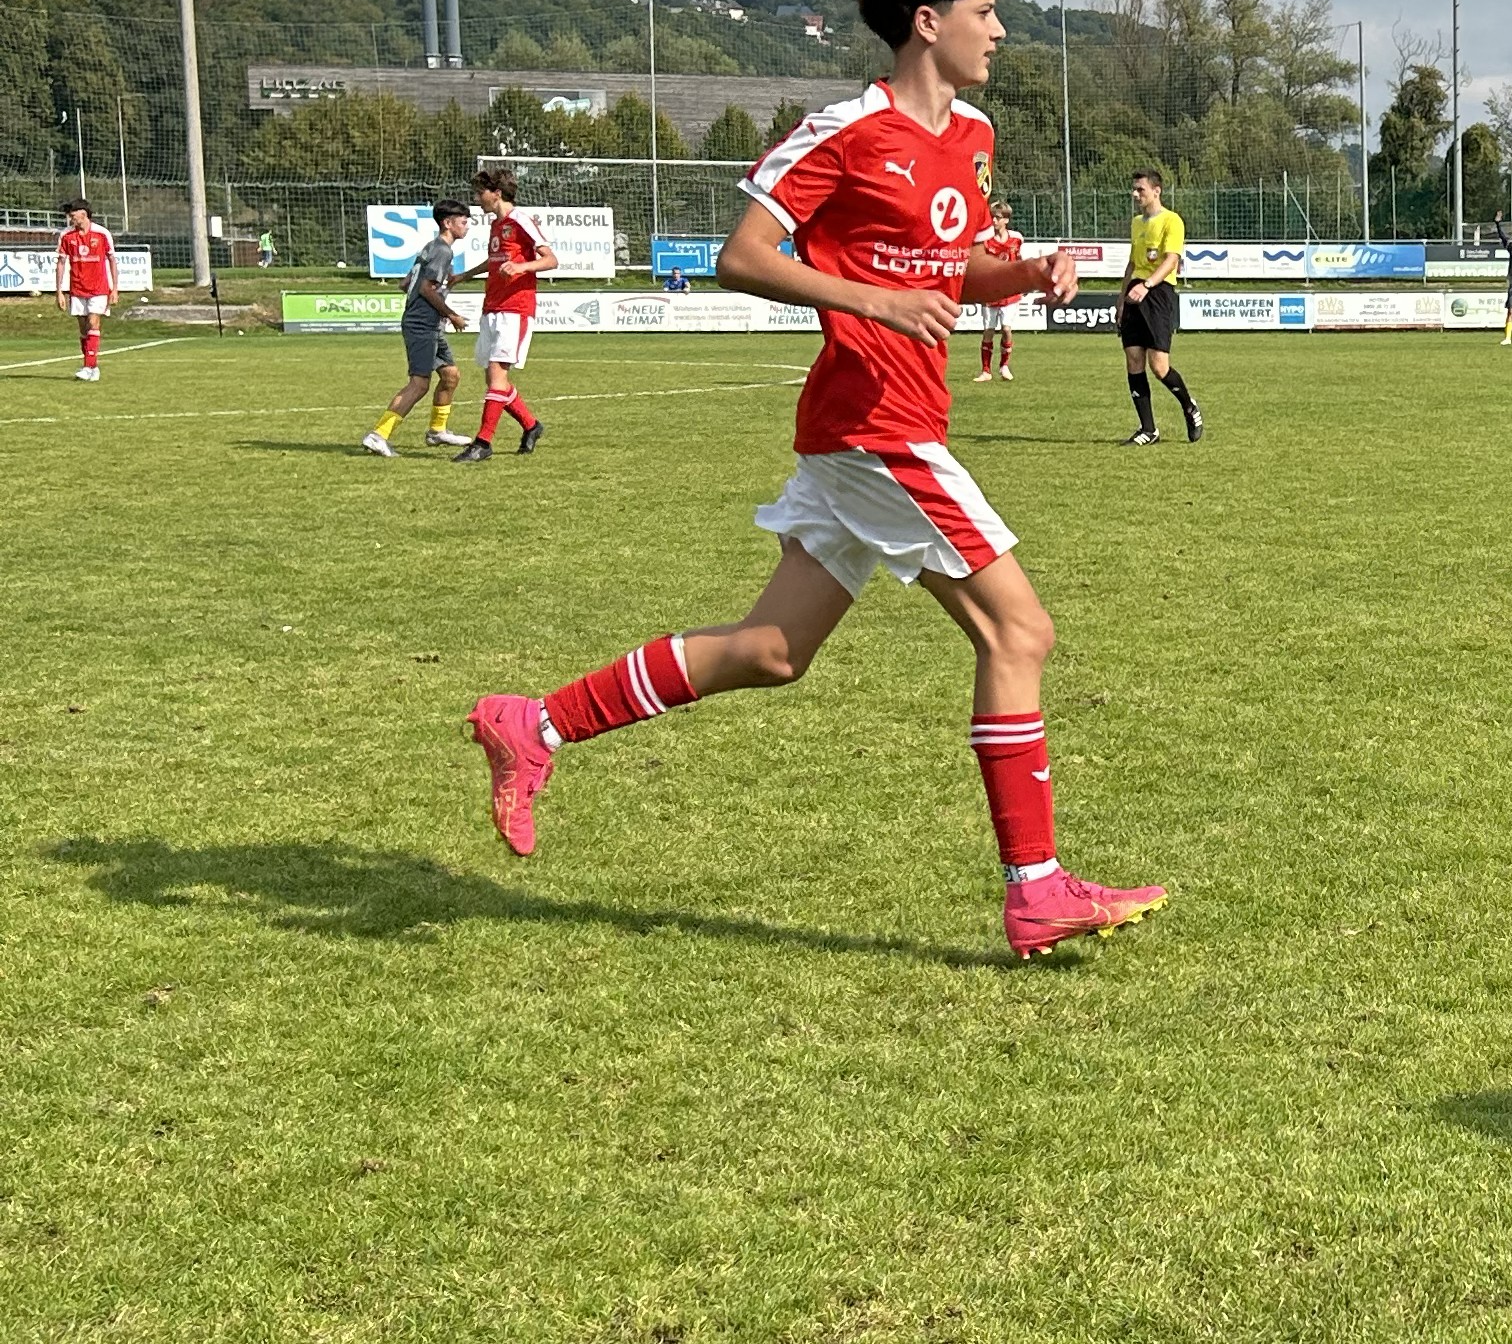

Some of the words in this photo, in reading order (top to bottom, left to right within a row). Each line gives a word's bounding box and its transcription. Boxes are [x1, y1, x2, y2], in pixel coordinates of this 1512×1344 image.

[547, 214, 609, 227] PRASCHL
[1189, 299, 1211, 307] WIR
[1215, 299, 1274, 307] SCHAFFEN
[1202, 309, 1235, 318] MEHR
[616, 316, 665, 325] HEIMAT
[768, 316, 815, 324] HEIMAT
